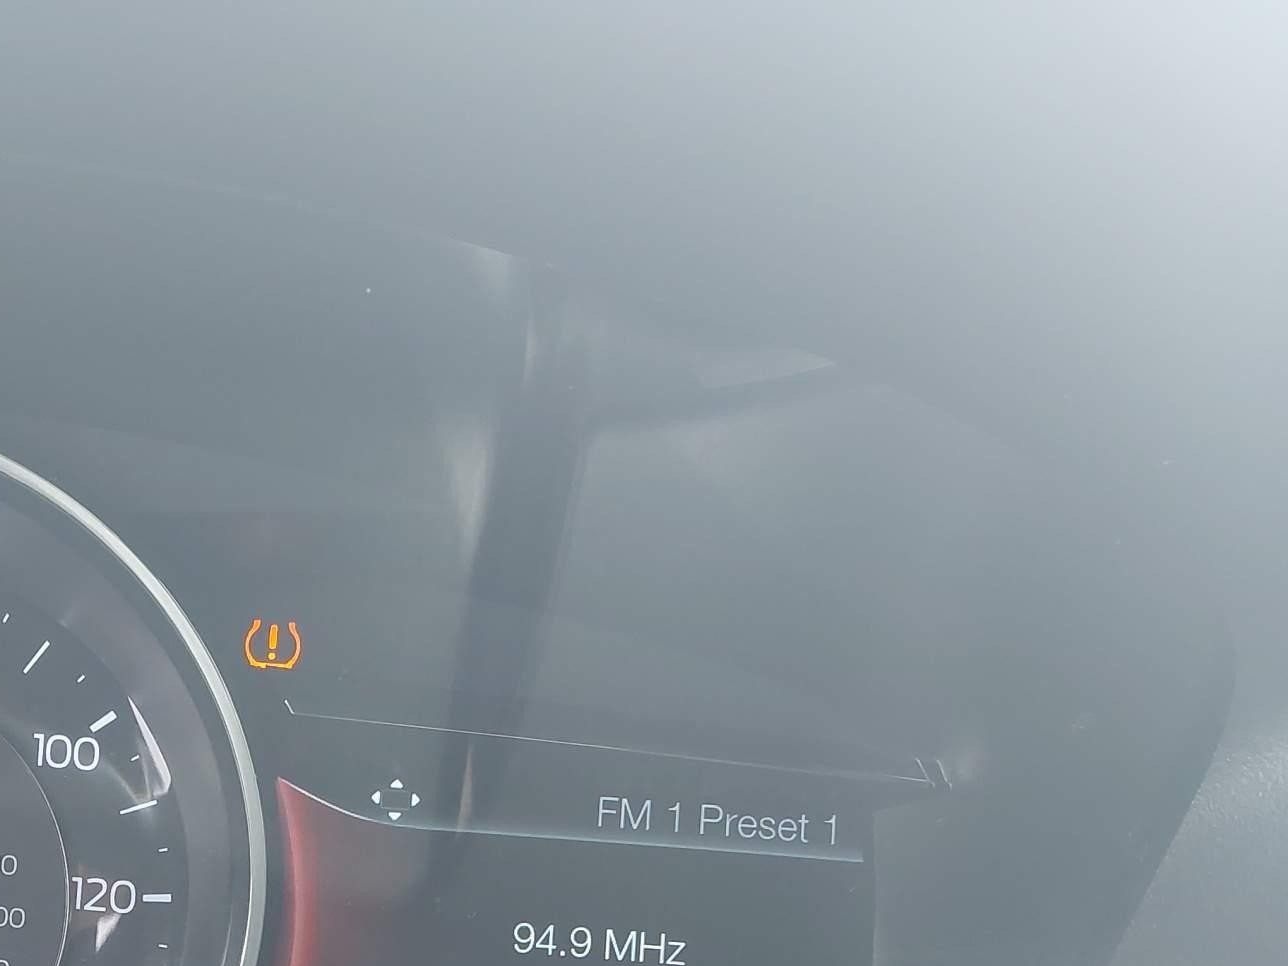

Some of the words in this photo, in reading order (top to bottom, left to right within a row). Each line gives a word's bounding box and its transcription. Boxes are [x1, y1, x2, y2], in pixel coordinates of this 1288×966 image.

[34, 733, 100, 771] 100
[597, 795, 652, 832] FM
[667, 802, 682, 834] 1
[698, 803, 810, 843] Preset
[823, 812, 839, 844] 1
[71, 877, 136, 914] 120
[512, 921, 592, 959] 94.9
[604, 929, 687, 966] MHz
